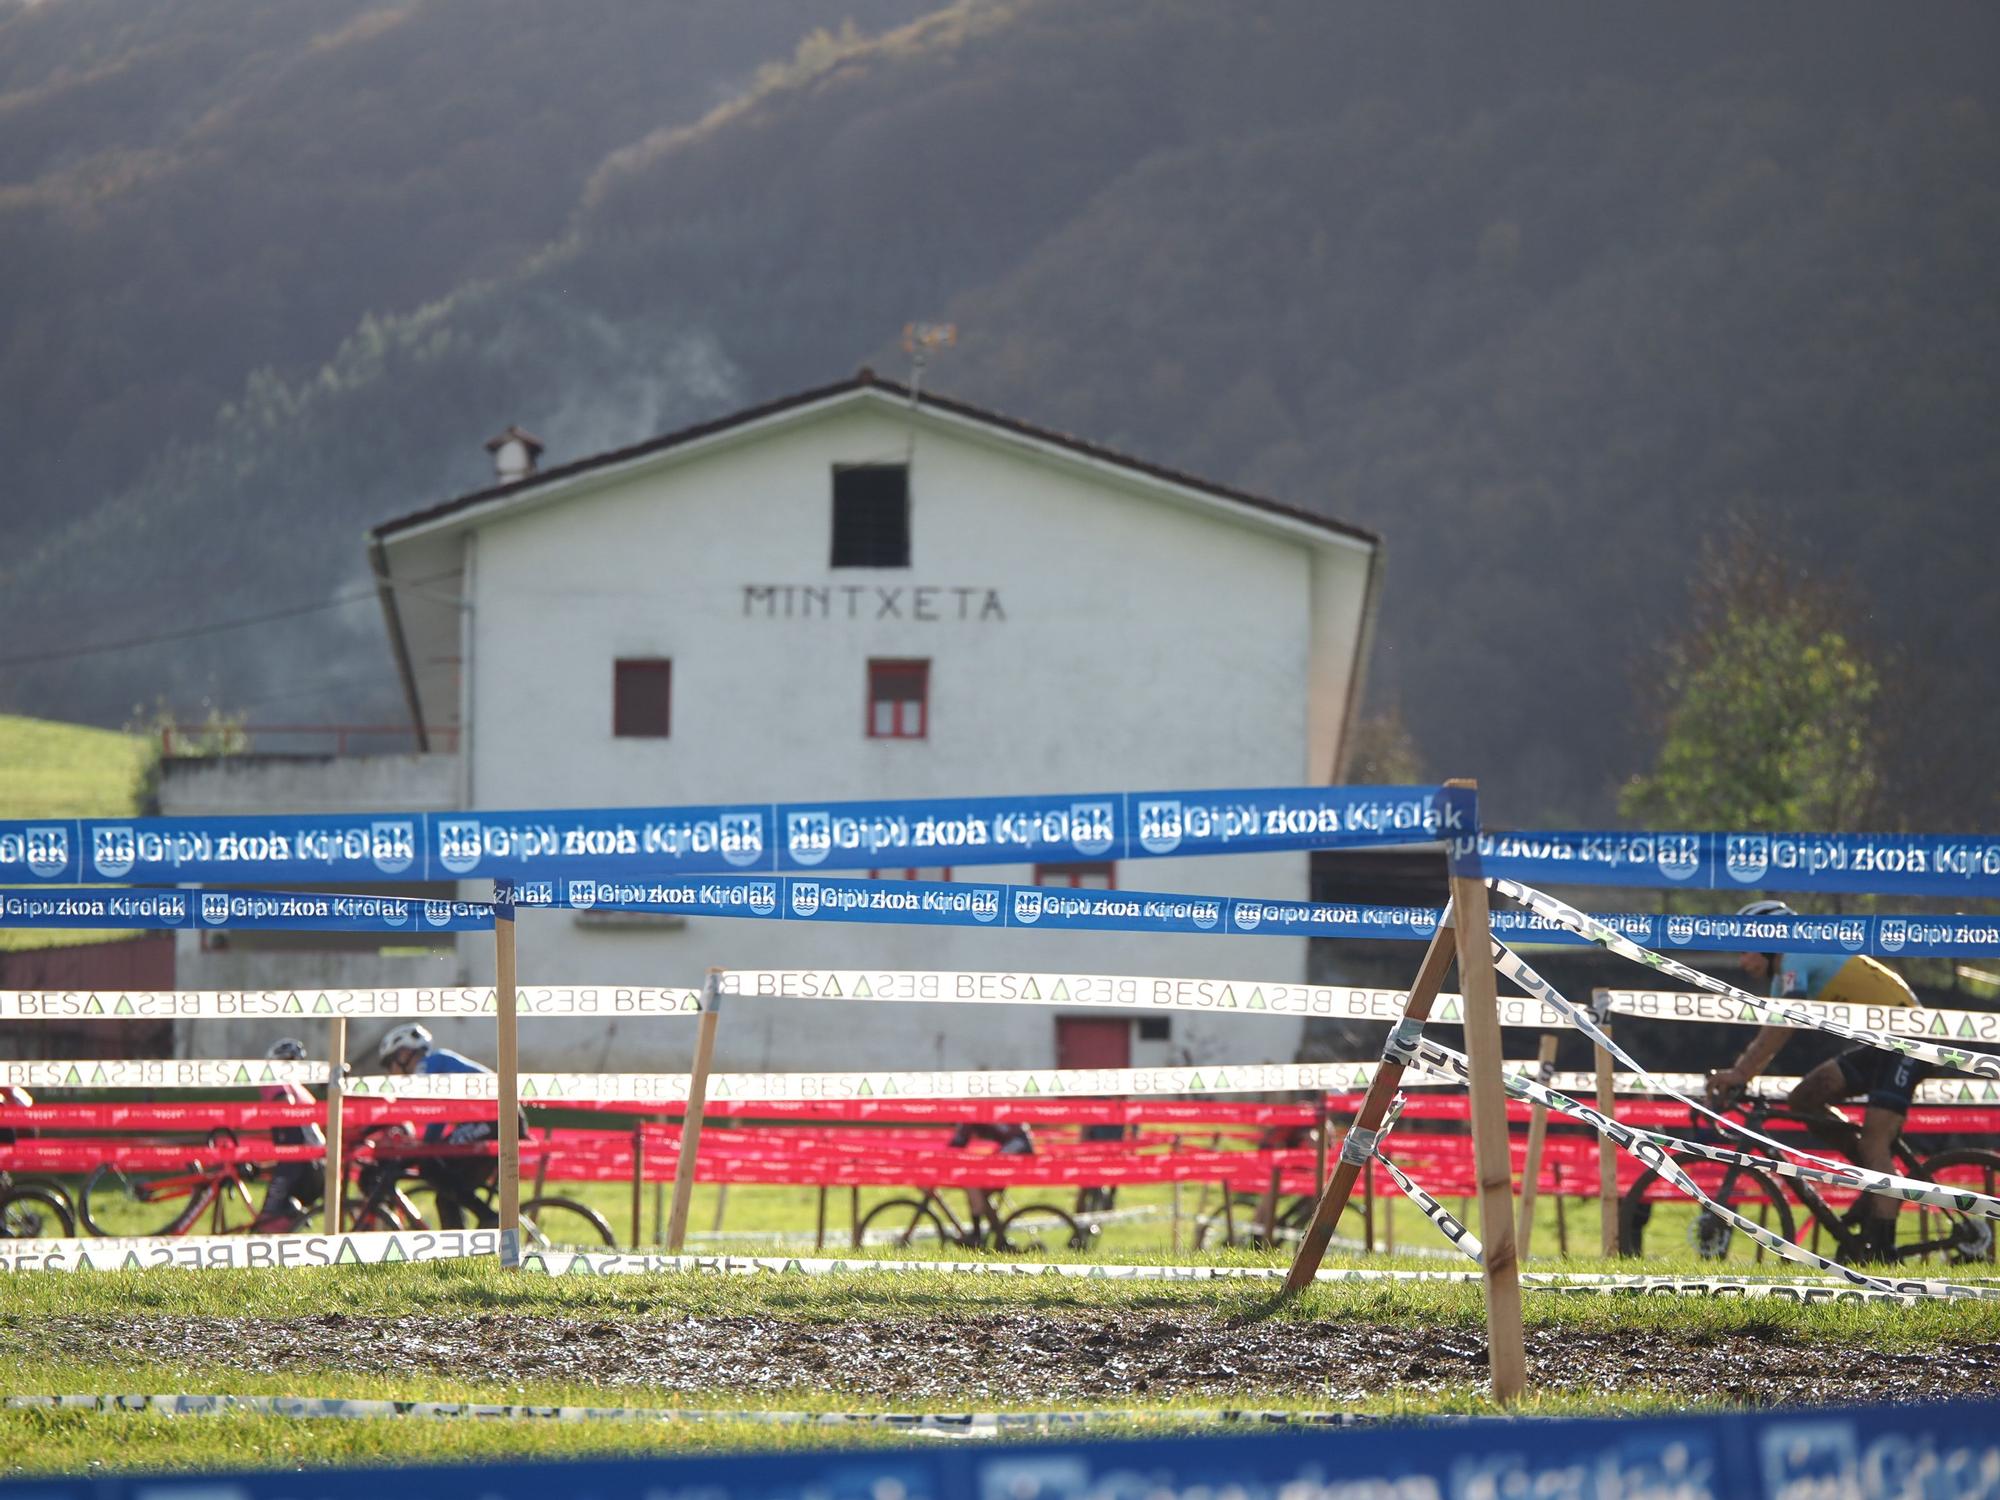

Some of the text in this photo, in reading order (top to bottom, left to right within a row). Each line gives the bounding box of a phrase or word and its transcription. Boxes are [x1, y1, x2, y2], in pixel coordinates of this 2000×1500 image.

[742, 585, 1007, 622] MINTXETA
[833, 808, 1114, 854] Gipuzkoa Kirolak
[1184, 800, 1463, 842] Gipuzkoa Kirolak
[138, 829, 414, 868] Gipuzkoa Kirolak
[483, 820, 763, 862] Gipuzkoa Kirolak
[1771, 841, 1928, 875] Gipuzkoa
[7, 896, 185, 918] Gipuzkoa Kirolak
[597, 883, 776, 907] Gipuzkoa Kirolak
[821, 886, 999, 914] Gipuzkoa Kirolak
[231, 897, 408, 919] Gipuzkoa Kirolak
[1042, 895, 1218, 921] Gipuzkoa Kirolak
[1262, 904, 1437, 927] Gipuzkoa Kirolak
[1695, 918, 1864, 942] Gipuzkoa Kirolak
[1907, 922, 1999, 946] Gipuzkoa
[756, 973, 844, 998] BESA
[956, 974, 1042, 1001] BESA
[1153, 980, 1238, 1008] BESA
[18, 993, 104, 1015] BESA
[217, 991, 304, 1014] BESA
[417, 989, 497, 1012] BESA
[615, 989, 702, 1012] BESA
[1348, 991, 1430, 1019] BES
[1675, 995, 1758, 1023] BESA
[1866, 1007, 1949, 1037] BESA
[8, 1064, 82, 1084] BESA
[178, 1063, 250, 1084] BESA
[968, 1075, 1040, 1096] BESA
[1134, 1071, 1206, 1092] BESA
[1298, 1066, 1370, 1087] BESA
[634, 1077, 686, 1097] BES
[801, 1077, 874, 1097] BESA
[247, 1236, 363, 1267] BESA
